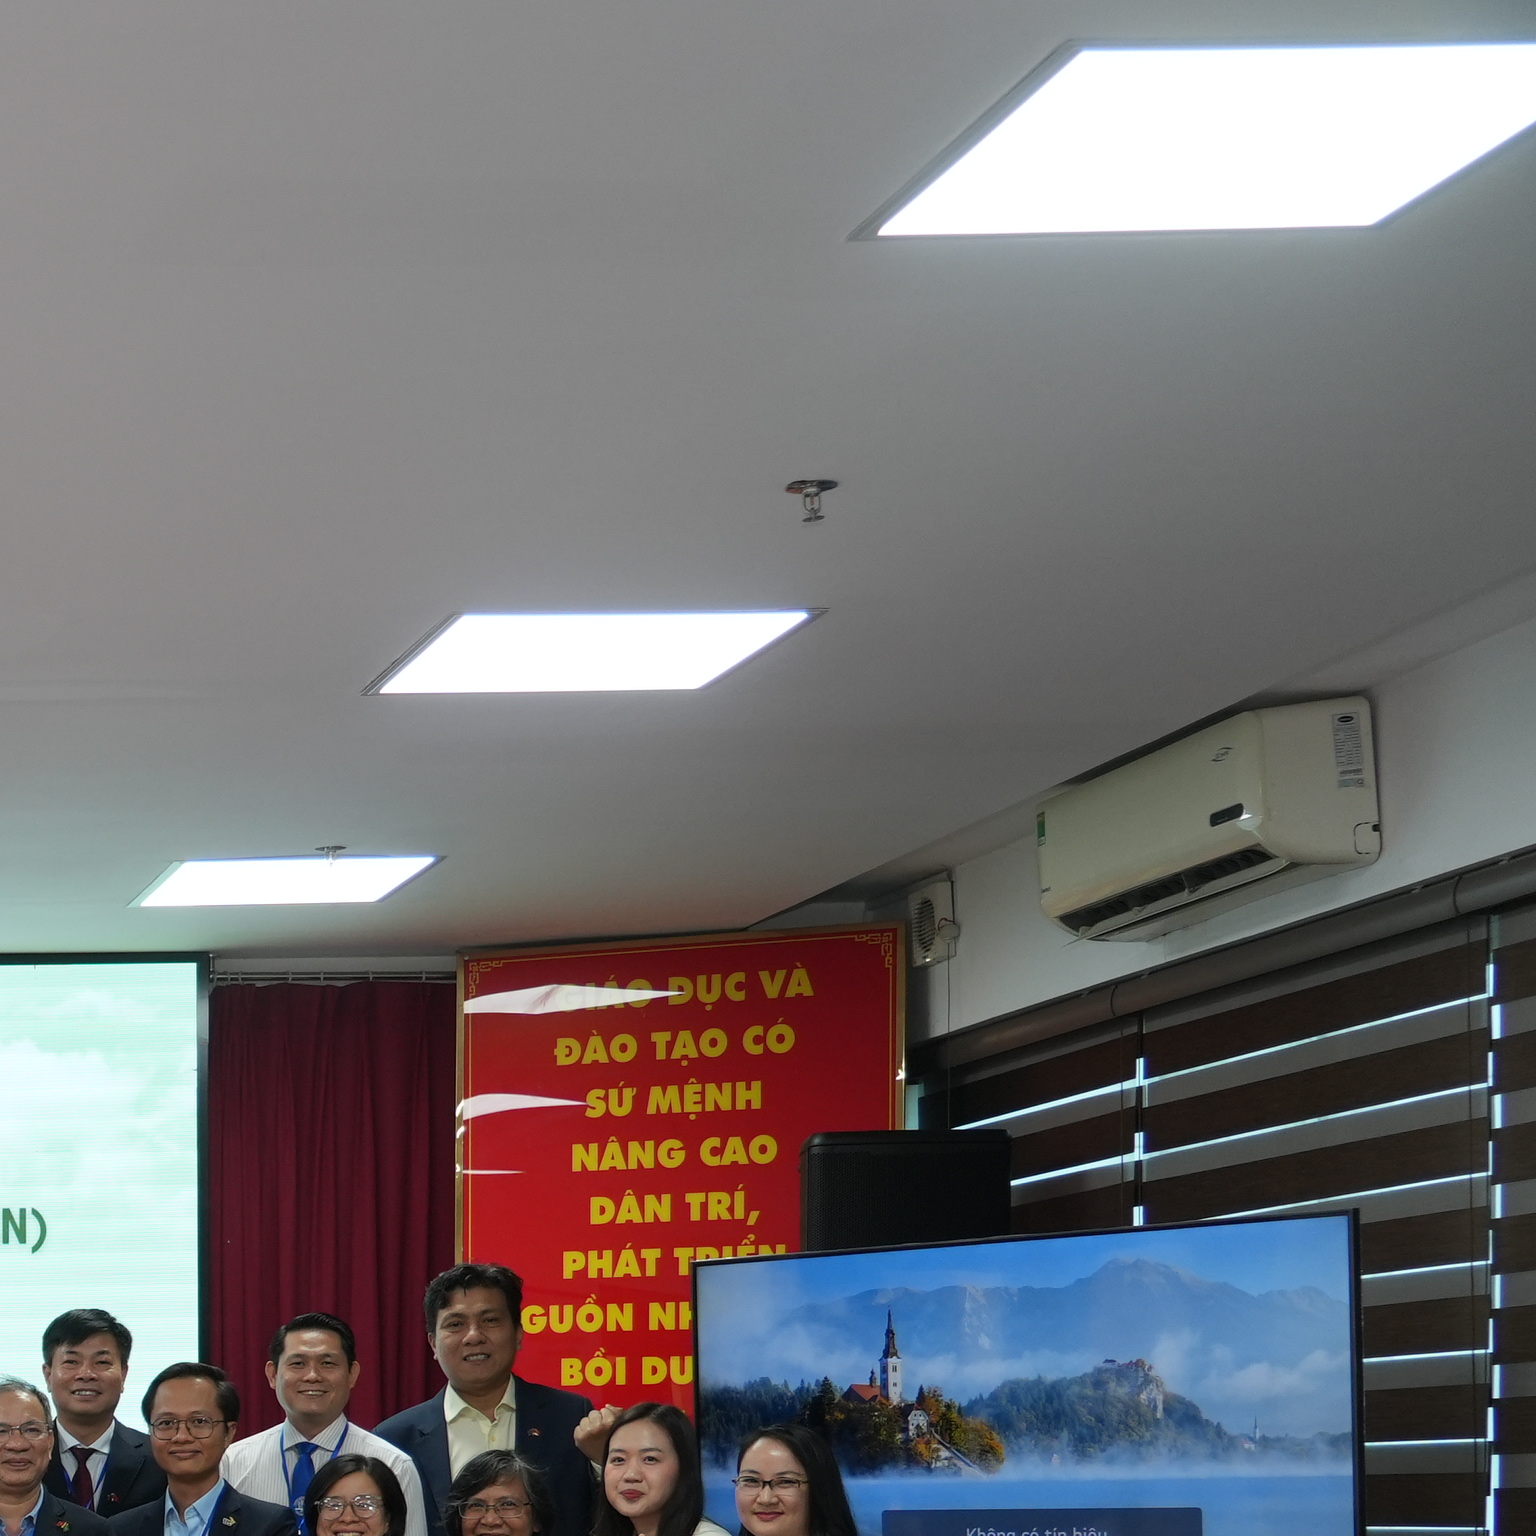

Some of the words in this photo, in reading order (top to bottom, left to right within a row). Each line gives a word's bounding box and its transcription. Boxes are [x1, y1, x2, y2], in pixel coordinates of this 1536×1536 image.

[668, 972, 746, 1011] DỤC
[758, 962, 814, 999] VÀ
[554, 1030, 638, 1066] ĐÀO
[651, 1028, 728, 1066] TẠO
[743, 1018, 795, 1055] CÓ
[585, 1082, 636, 1118] SỨ
[647, 1078, 761, 1120] MỆNH
[572, 1136, 686, 1172] NÂNG
[700, 1135, 778, 1166] CAO
[590, 1189, 671, 1225] DÂN
[685, 1184, 760, 1226] TRÍ,
[563, 1243, 661, 1279] PHÁT
[521, 1294, 633, 1334] GUỒN
[561, 1347, 626, 1386] BỒI
